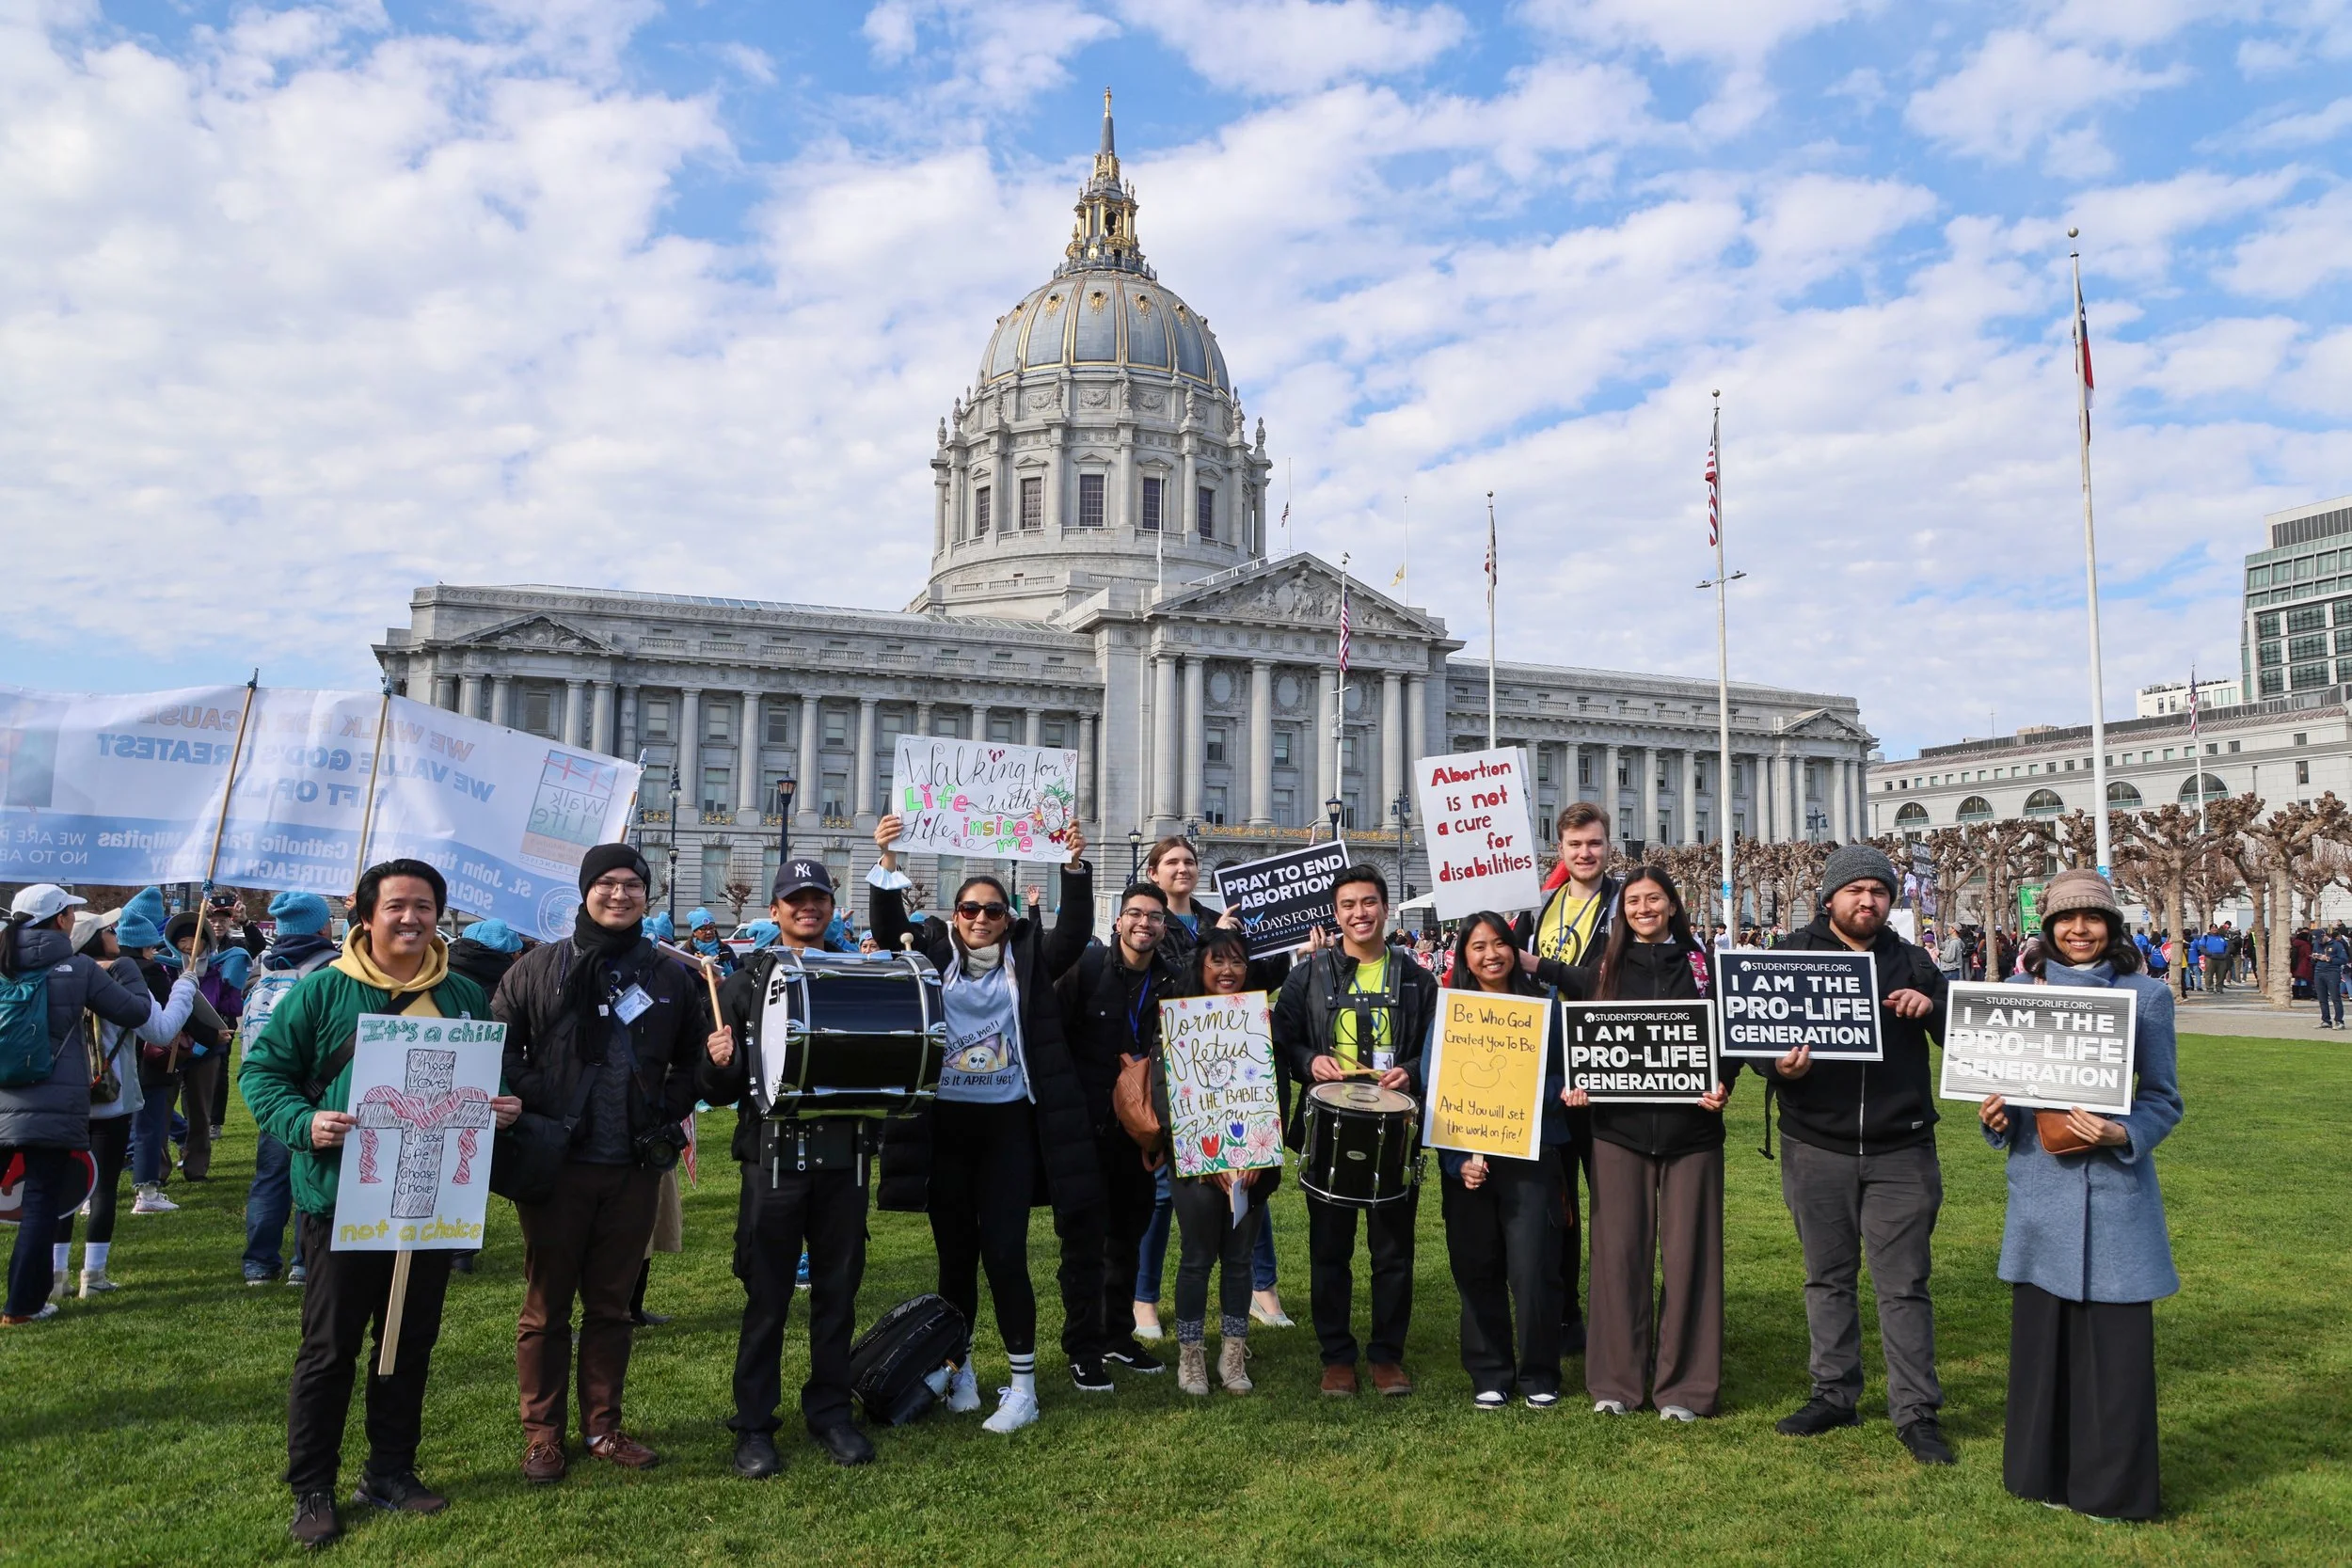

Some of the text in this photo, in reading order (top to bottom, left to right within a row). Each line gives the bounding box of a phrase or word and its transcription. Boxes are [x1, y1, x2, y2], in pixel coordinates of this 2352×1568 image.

[905, 743, 1061, 790] Walking for
[1431, 760, 1512, 786] Abortion
[904, 784, 1033, 812] Life with
[1447, 784, 1508, 812] is not
[901, 811, 954, 847] Life
[1438, 816, 1491, 836] a cure
[996, 836, 1033, 853] me
[1487, 832, 1513, 849] for
[1223, 854, 1343, 896] PRAY TO END
[1438, 852, 1533, 882] disabilities
[1240, 873, 1336, 911] ABORTION
[1259, 914, 1292, 932] DAYS
[1291, 908, 1320, 924] FOR
[1752, 962, 1851, 973] STUDENTSFORLIFE.ORG
[1732, 974, 1860, 993] I AM THE
[1725, 995, 1872, 1022] PRO-LIFE
[1986, 996, 2093, 1010] STUDENTSFORLIFE.ORG
[1454, 1004, 1532, 1029] Be Who God
[1595, 1012, 1690, 1021] STUDENTSFORLIFE.ORG
[1964, 1006, 2115, 1033] I AM THE
[361, 1020, 505, 1043] It's a child
[1444, 1030, 1484, 1047] Created
[1505, 1036, 1518, 1050] To
[1520, 1037, 1535, 1053] Be
[1576, 1024, 1697, 1041] I AM THE
[1730, 1024, 1869, 1045] GENERATION
[1190, 1034, 1258, 1082] fetus
[1570, 1045, 1708, 1069] PRO-LIFE
[1952, 1028, 2123, 1064] PRO-LIFE
[408, 1053, 454, 1072] Choose
[1954, 1058, 2119, 1088] GENERATION
[1574, 1073, 1706, 1090] GENERATION
[1226, 1085, 1275, 1105] BABIES
[1439, 1096, 1463, 1114] And
[1489, 1105, 1504, 1118] will
[1507, 1108, 1525, 1120] set
[404, 1131, 443, 1145] Choose
[1181, 1109, 1256, 1145] grow
[1447, 1118, 1522, 1144] the world on fire!
[340, 1218, 484, 1242] not a choice
